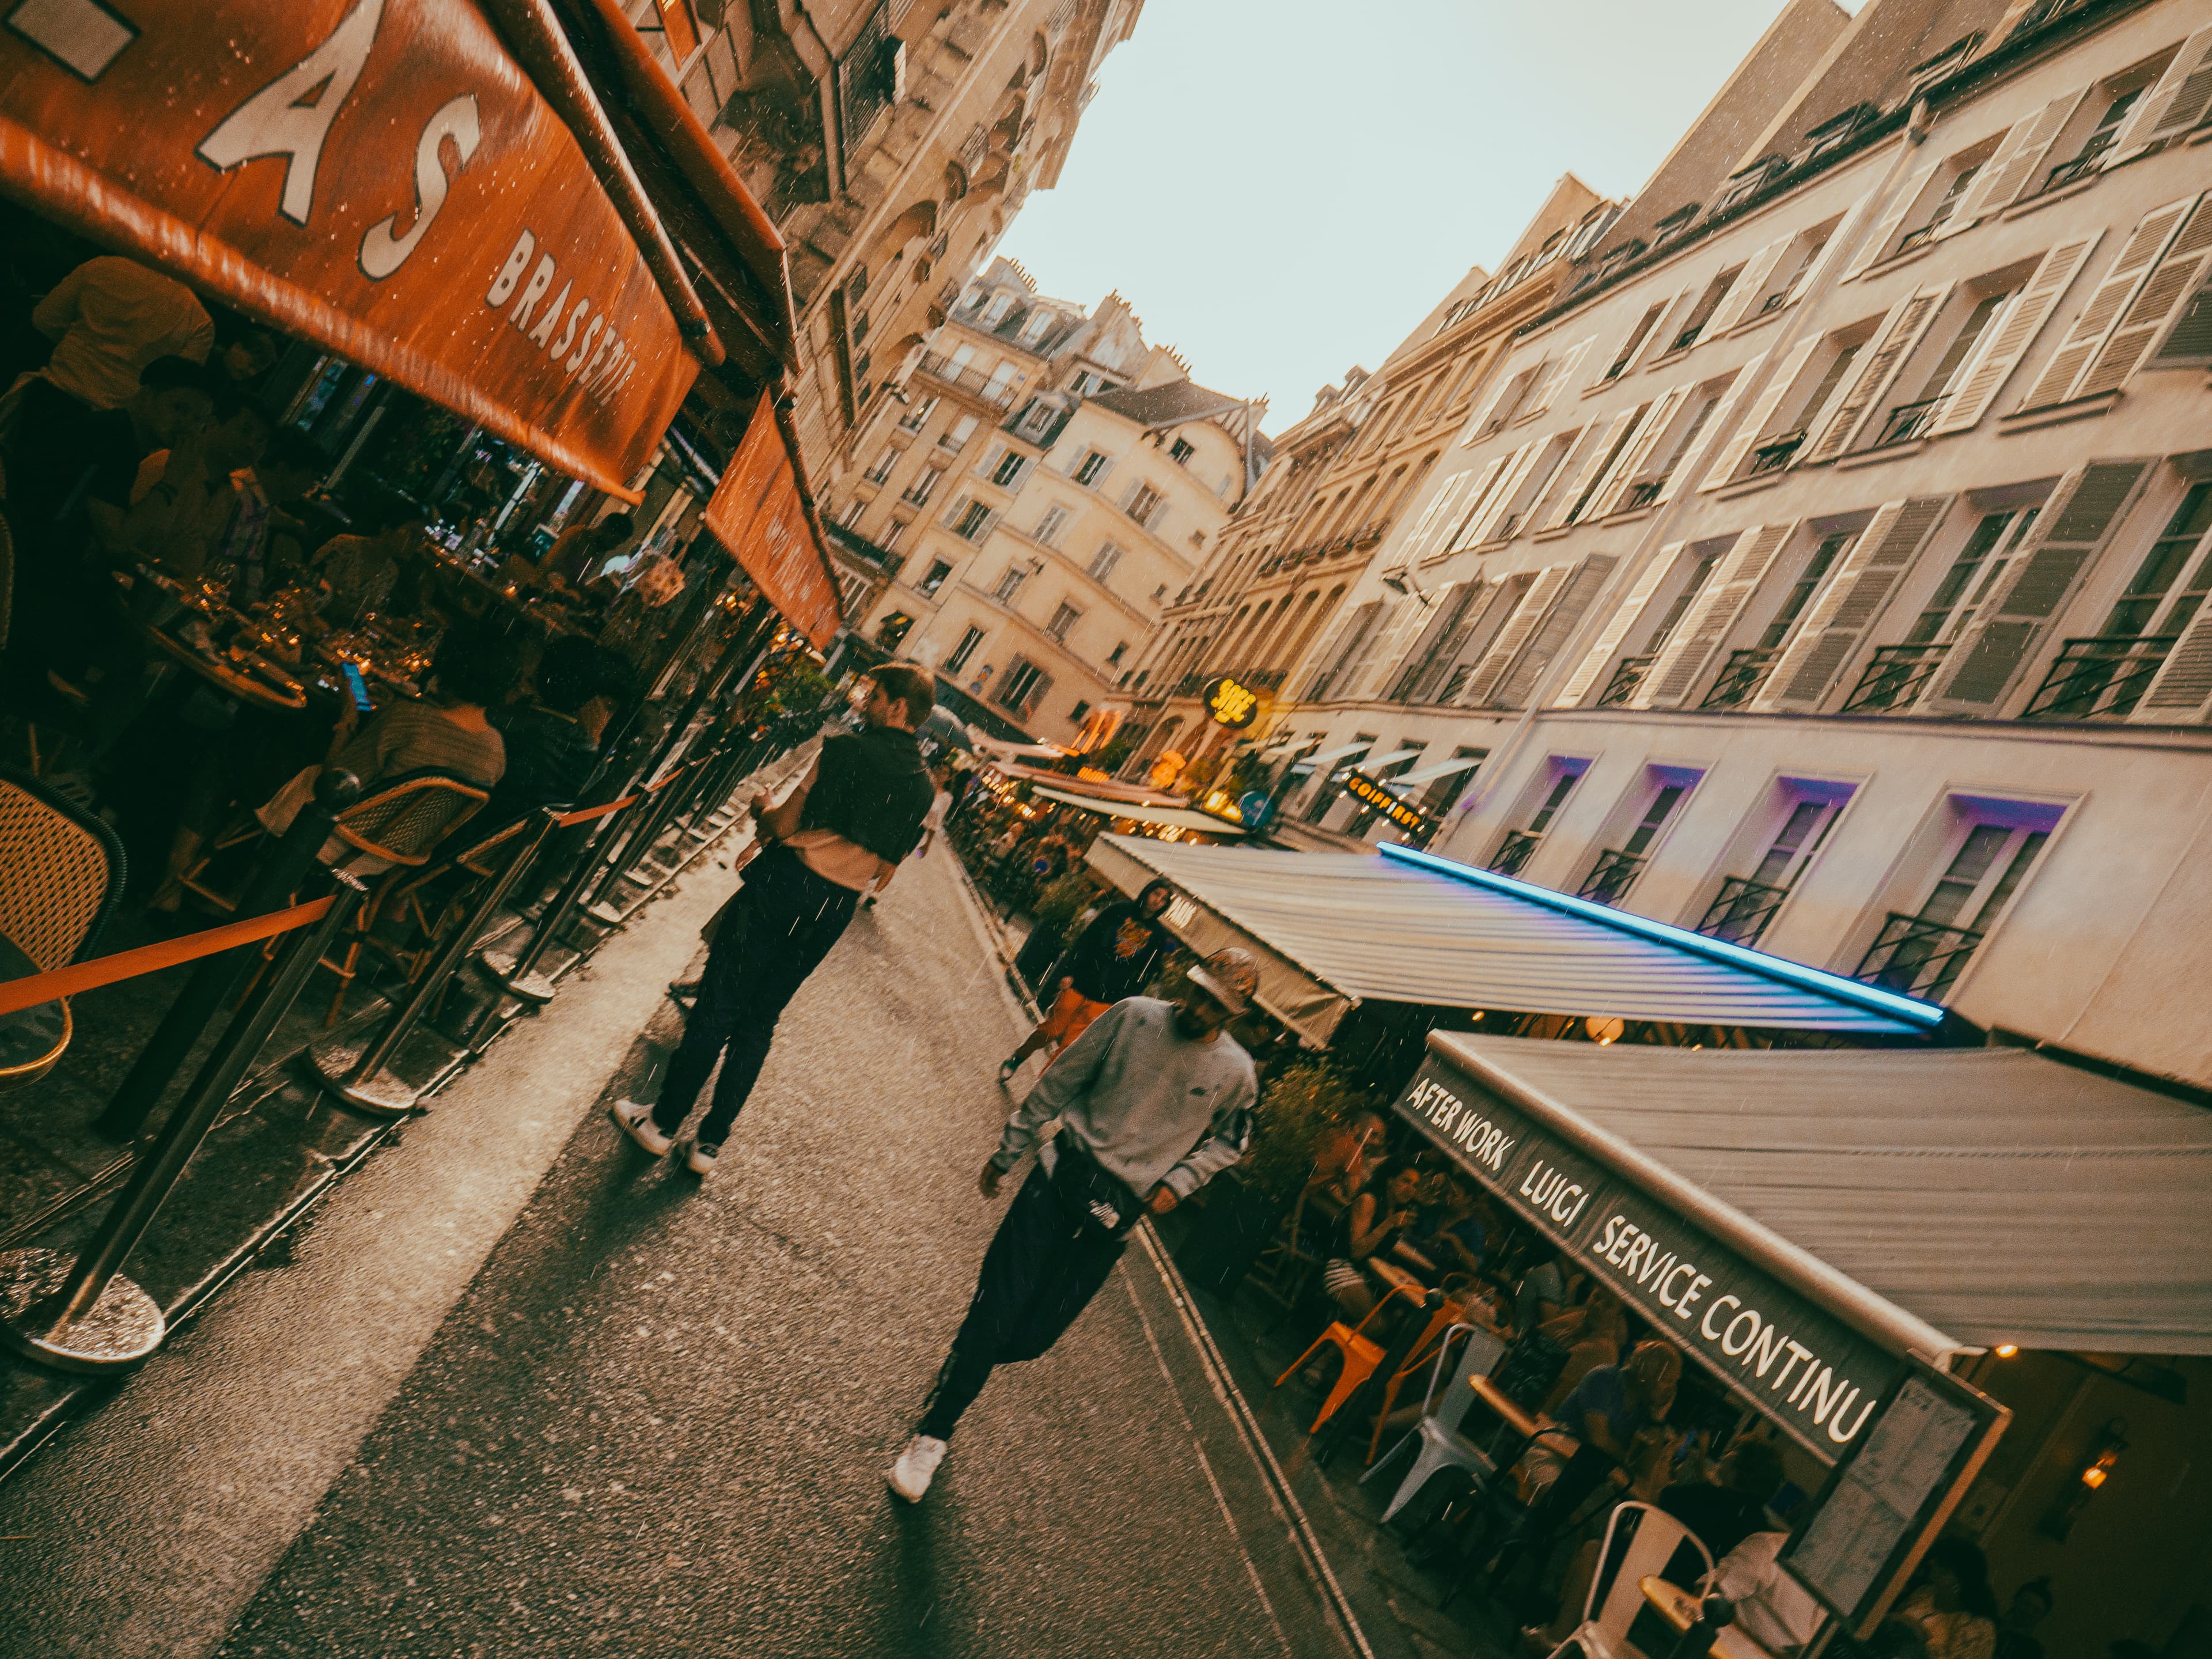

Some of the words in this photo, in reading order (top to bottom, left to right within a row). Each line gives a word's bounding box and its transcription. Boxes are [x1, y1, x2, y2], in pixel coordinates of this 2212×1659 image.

[486, 228, 638, 408] BRASSERIE
[1406, 1076, 1464, 1132] AFTER
[1452, 1108, 1516, 1172] WORK
[1519, 1159, 1590, 1228] LUIGI
[1592, 1214, 1713, 1320] SERVICE
[1700, 1294, 1877, 1443] CONTINU
